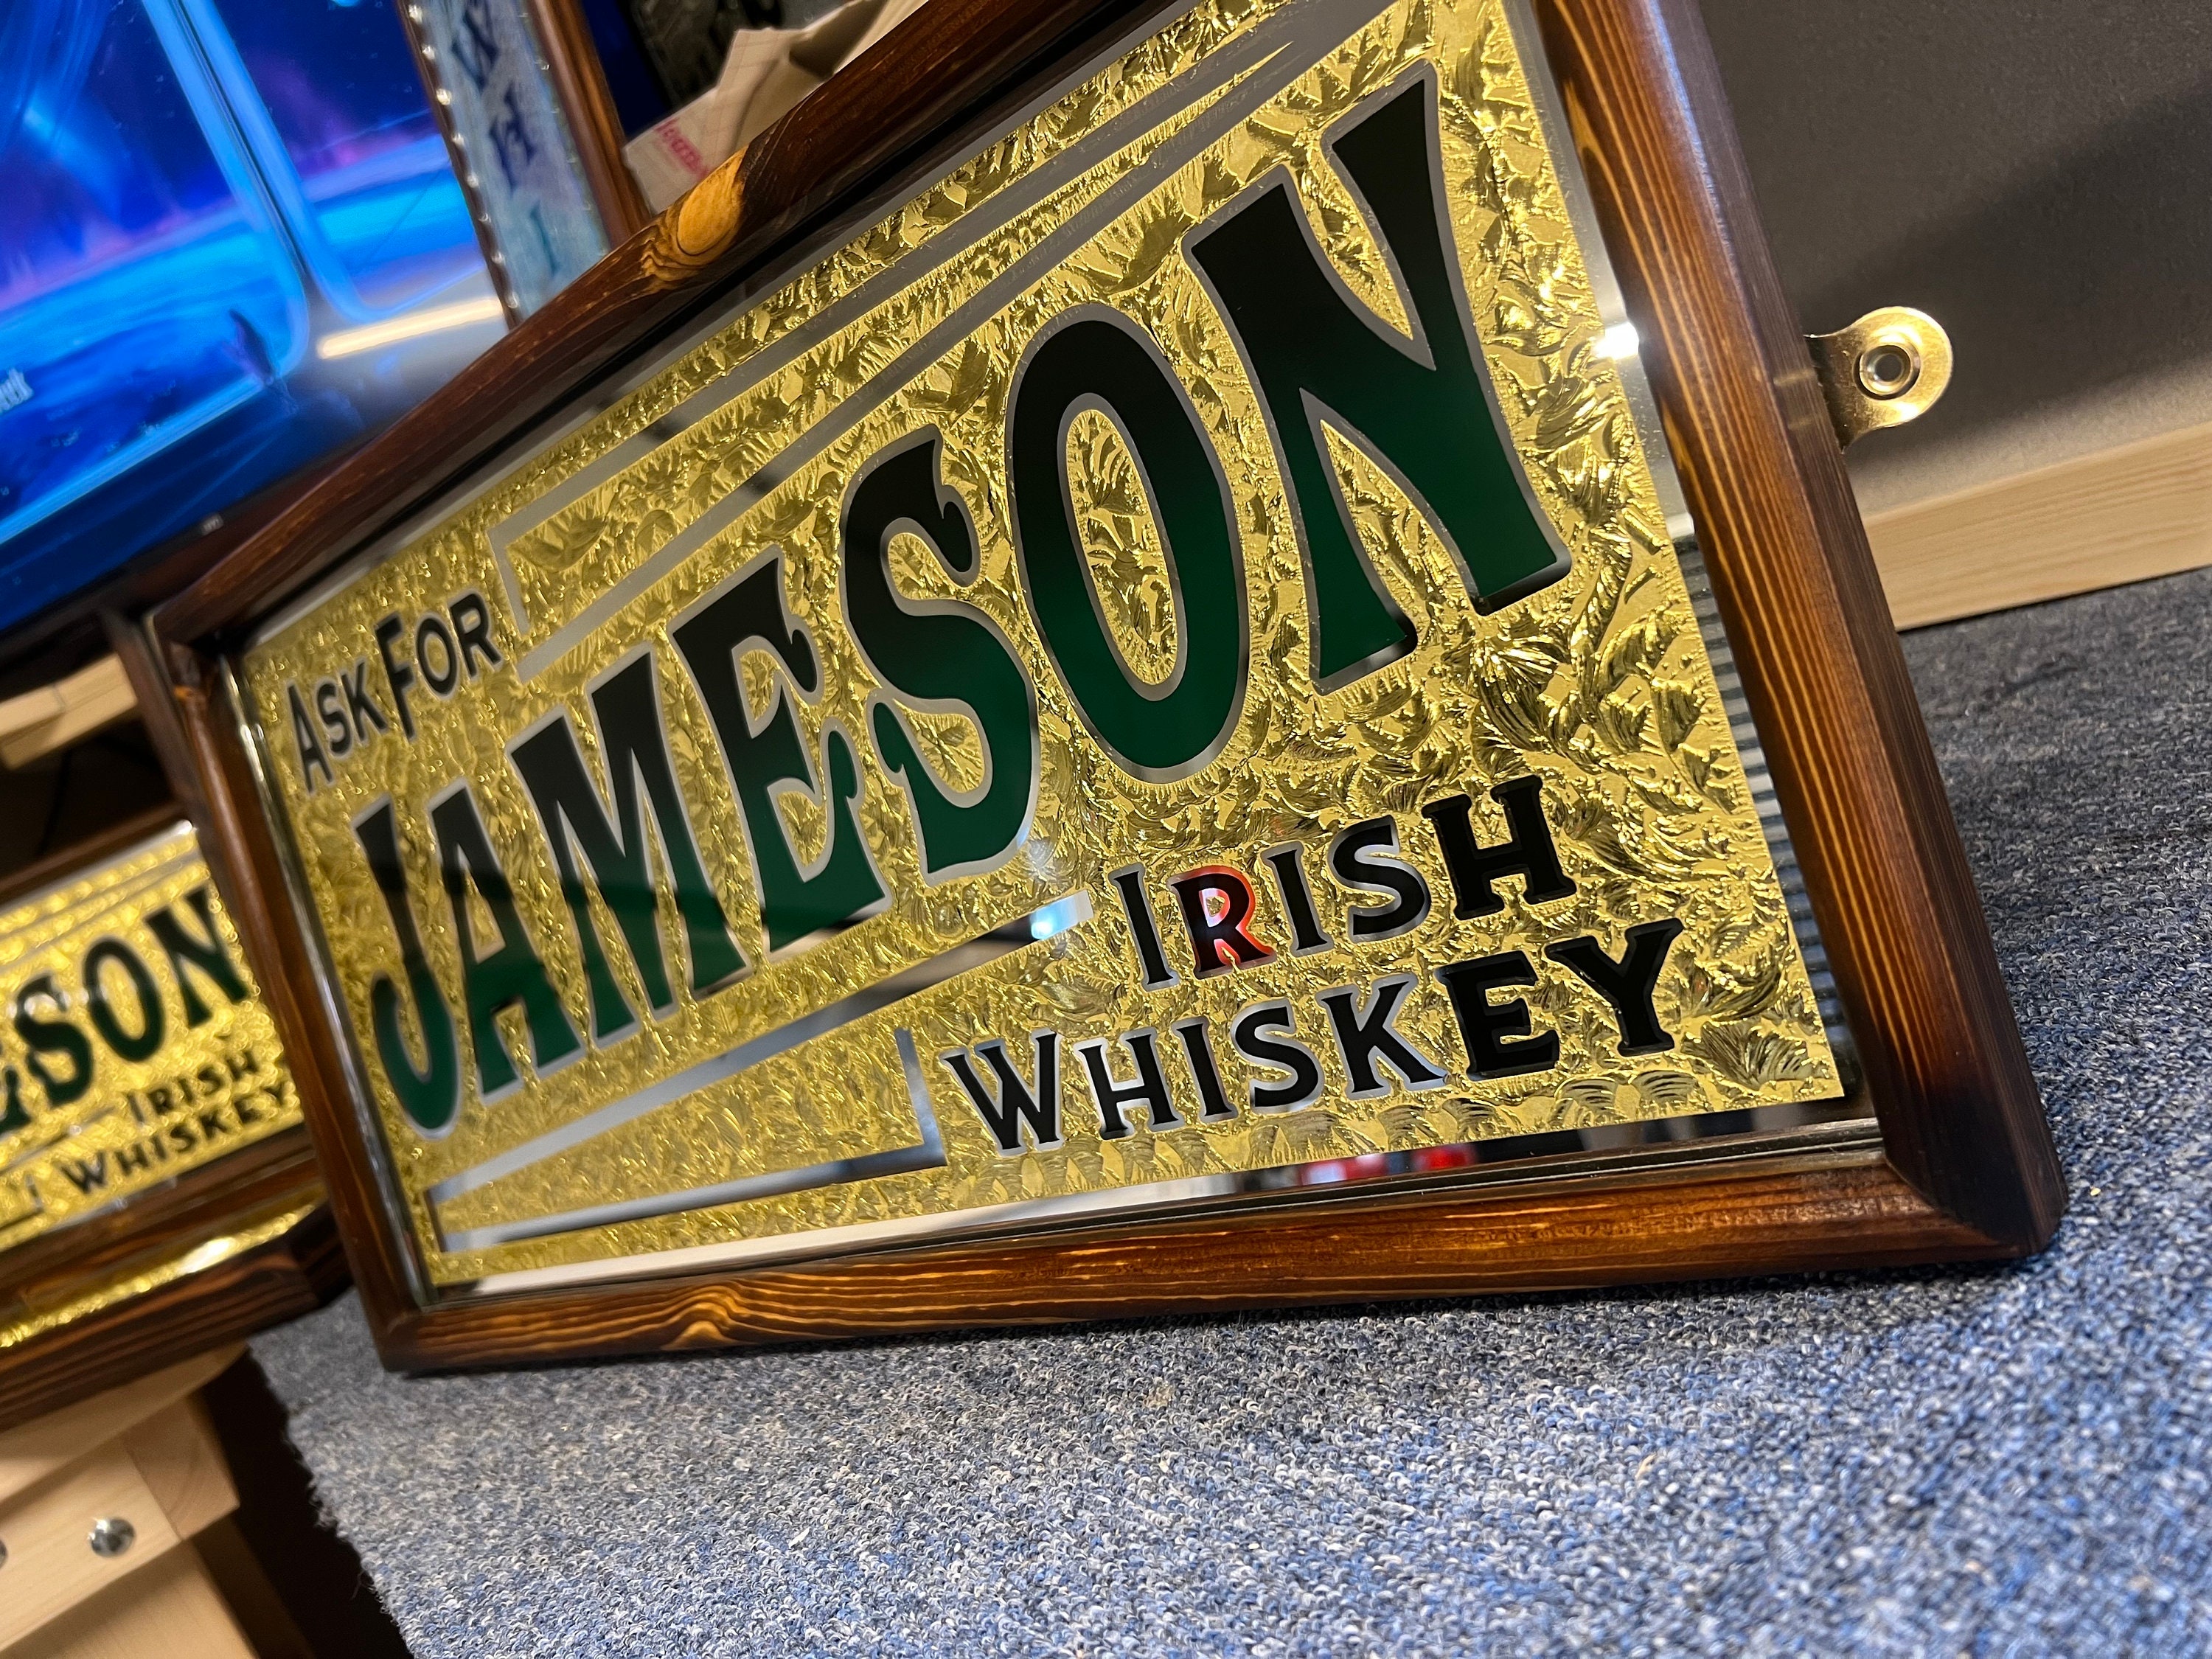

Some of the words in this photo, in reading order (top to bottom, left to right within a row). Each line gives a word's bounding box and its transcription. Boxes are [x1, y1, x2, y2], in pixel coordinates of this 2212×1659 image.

[352, 62, 1571, 1138] JAMESON
[1108, 774, 1577, 992] IRISH
[59, 1081, 291, 1194] WHISKEY
[127, 1050, 261, 1124] IRISH
[940, 918, 1684, 1156] WHISKEY
